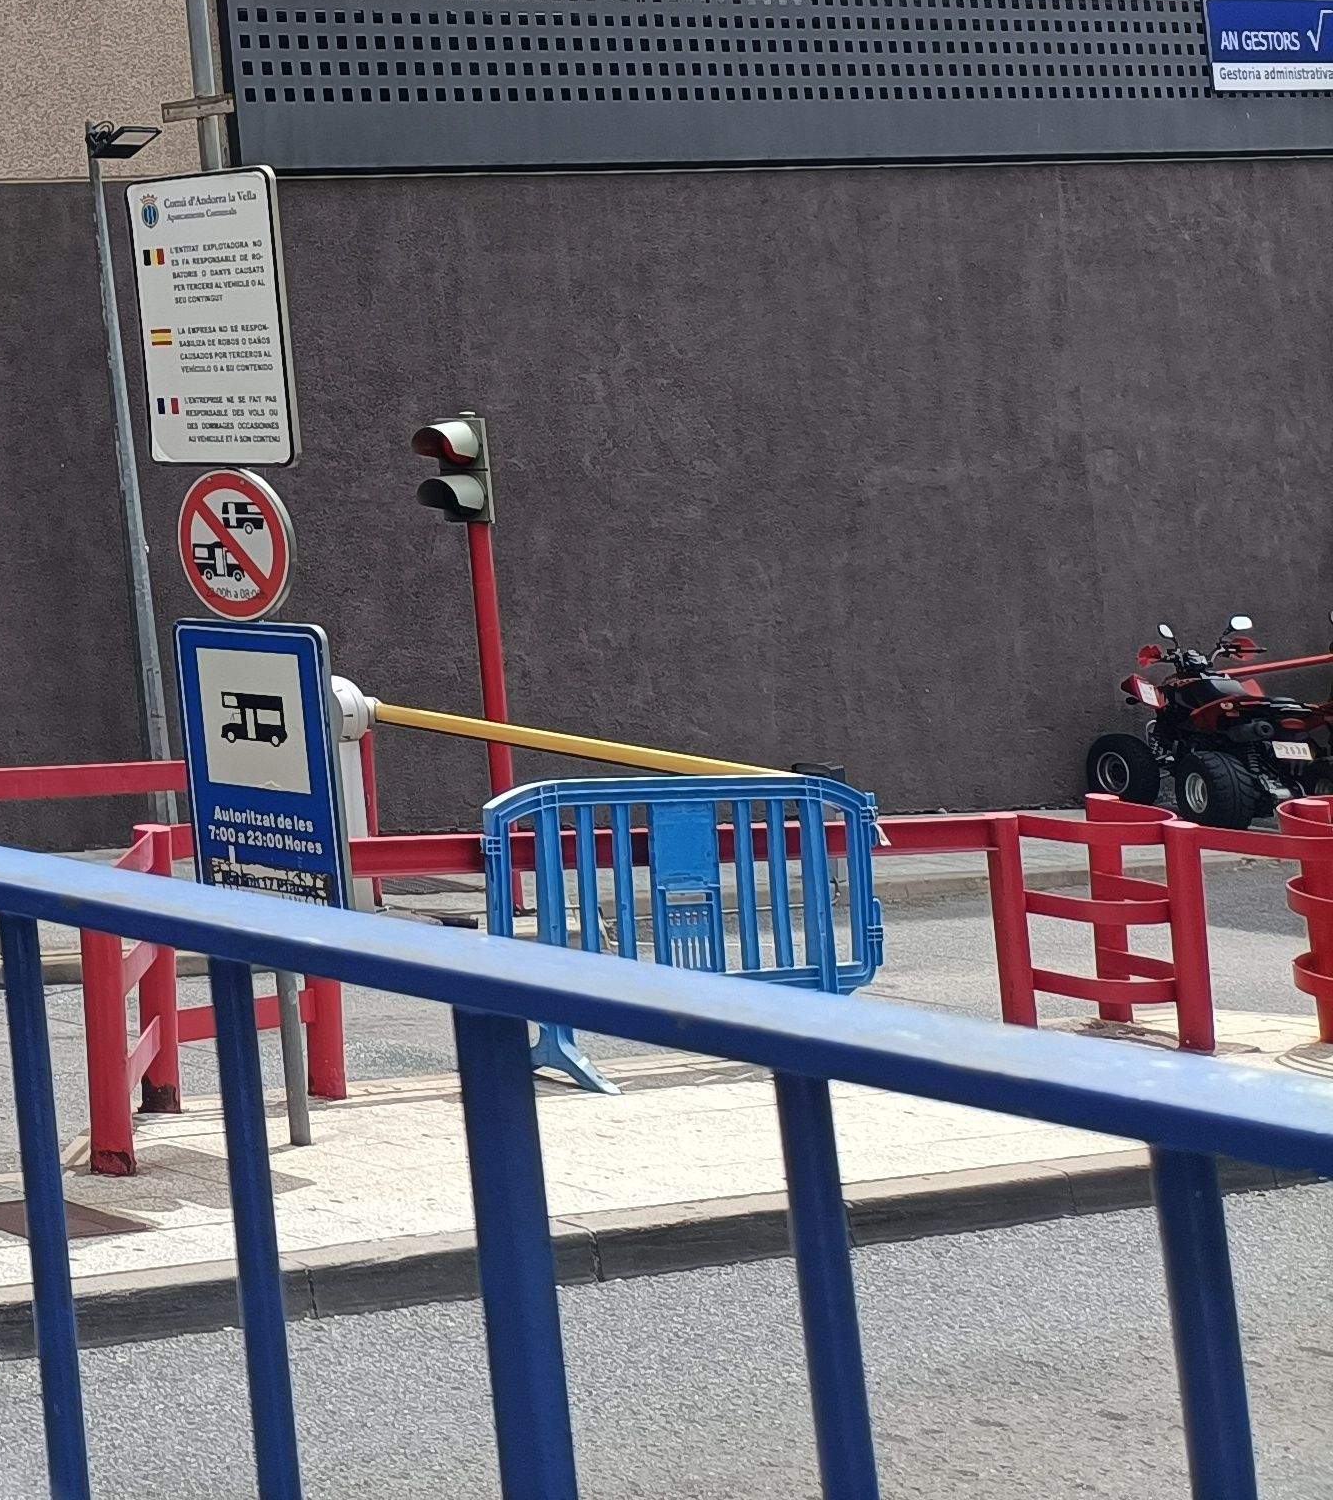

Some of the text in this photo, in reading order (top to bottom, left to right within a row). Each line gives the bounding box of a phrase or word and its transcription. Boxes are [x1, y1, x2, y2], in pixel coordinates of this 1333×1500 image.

[1221, 30, 1301, 51] AN GESTORS
[1220, 67, 1261, 80] Gestoria
[228, 193, 235, 202] la
[237, 191, 256, 200] Vella
[214, 805, 314, 833] Autoritzat de les
[208, 825, 323, 855] 7:00 a 23:00 Hores
